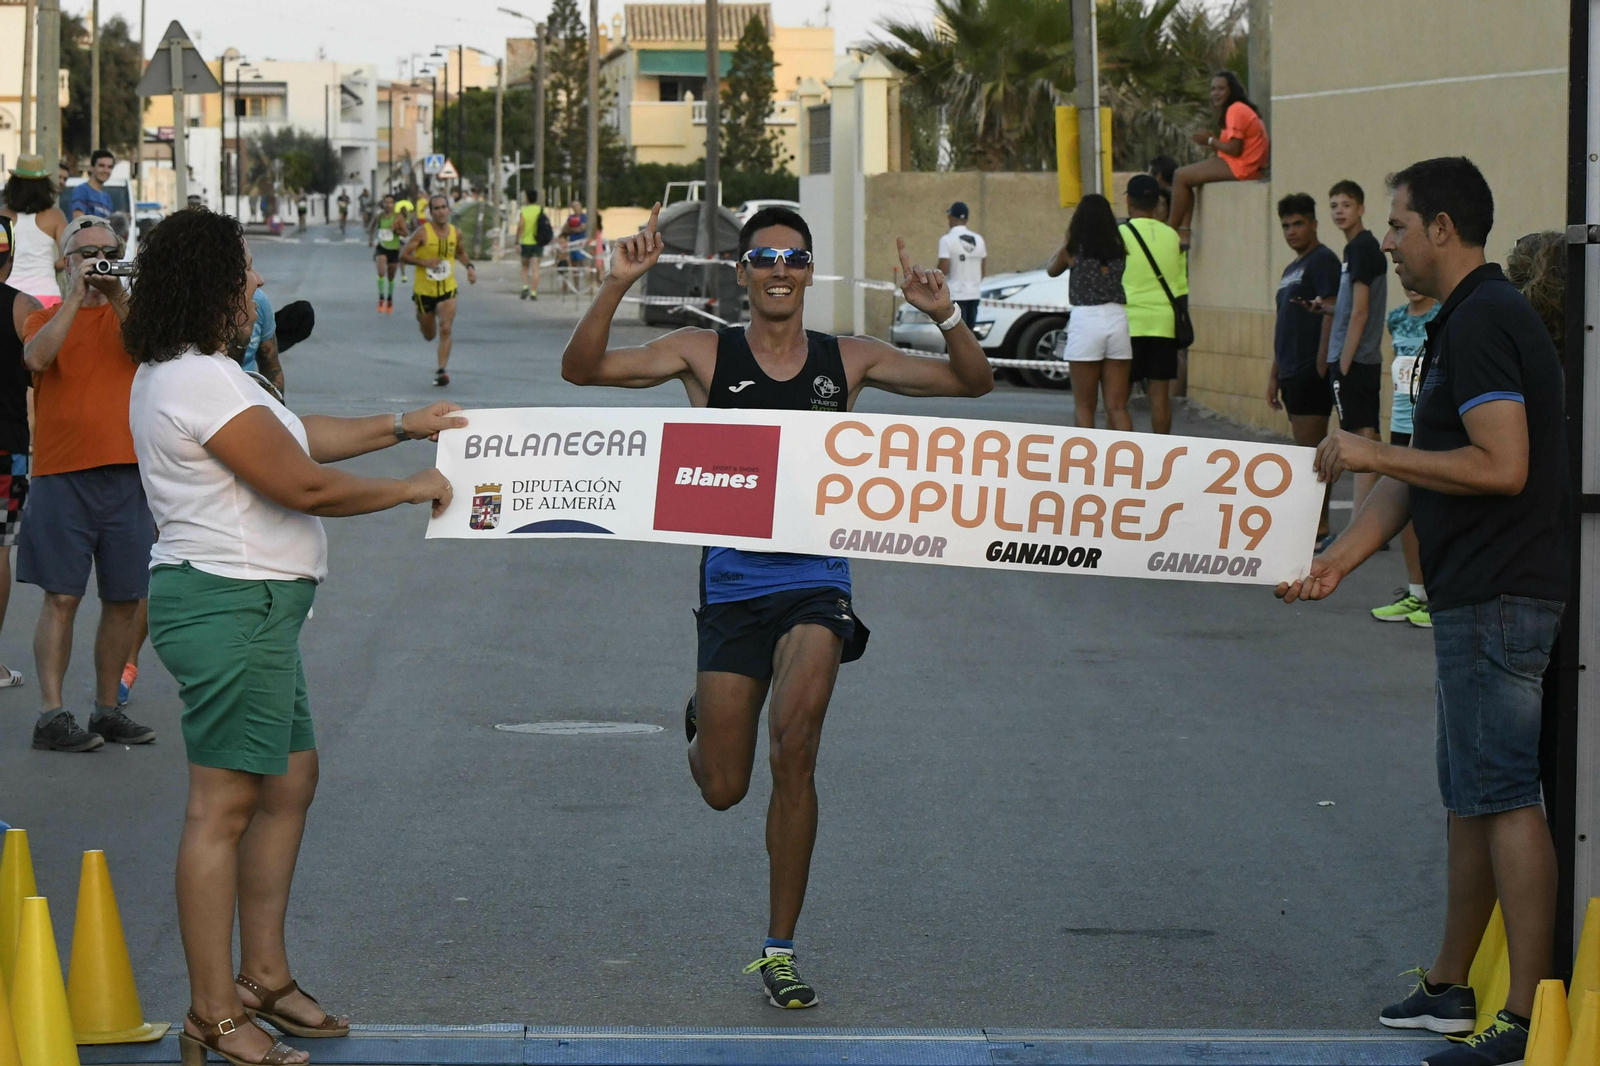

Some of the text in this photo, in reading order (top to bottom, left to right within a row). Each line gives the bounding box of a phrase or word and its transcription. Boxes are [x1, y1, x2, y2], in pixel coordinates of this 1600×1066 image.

[464, 429, 647, 460] BALANEGRA
[824, 420, 1293, 499] CARRERAS 20
[512, 477, 622, 494] DIPUTACIÓN
[674, 466, 759, 490] Blanes
[512, 493, 617, 511] DE ALMERÍA
[815, 473, 1273, 551] POPULARES 19
[829, 528, 948, 559] GANADOR
[985, 540, 1103, 569] GANADOR
[1146, 551, 1263, 578] GANADOR
